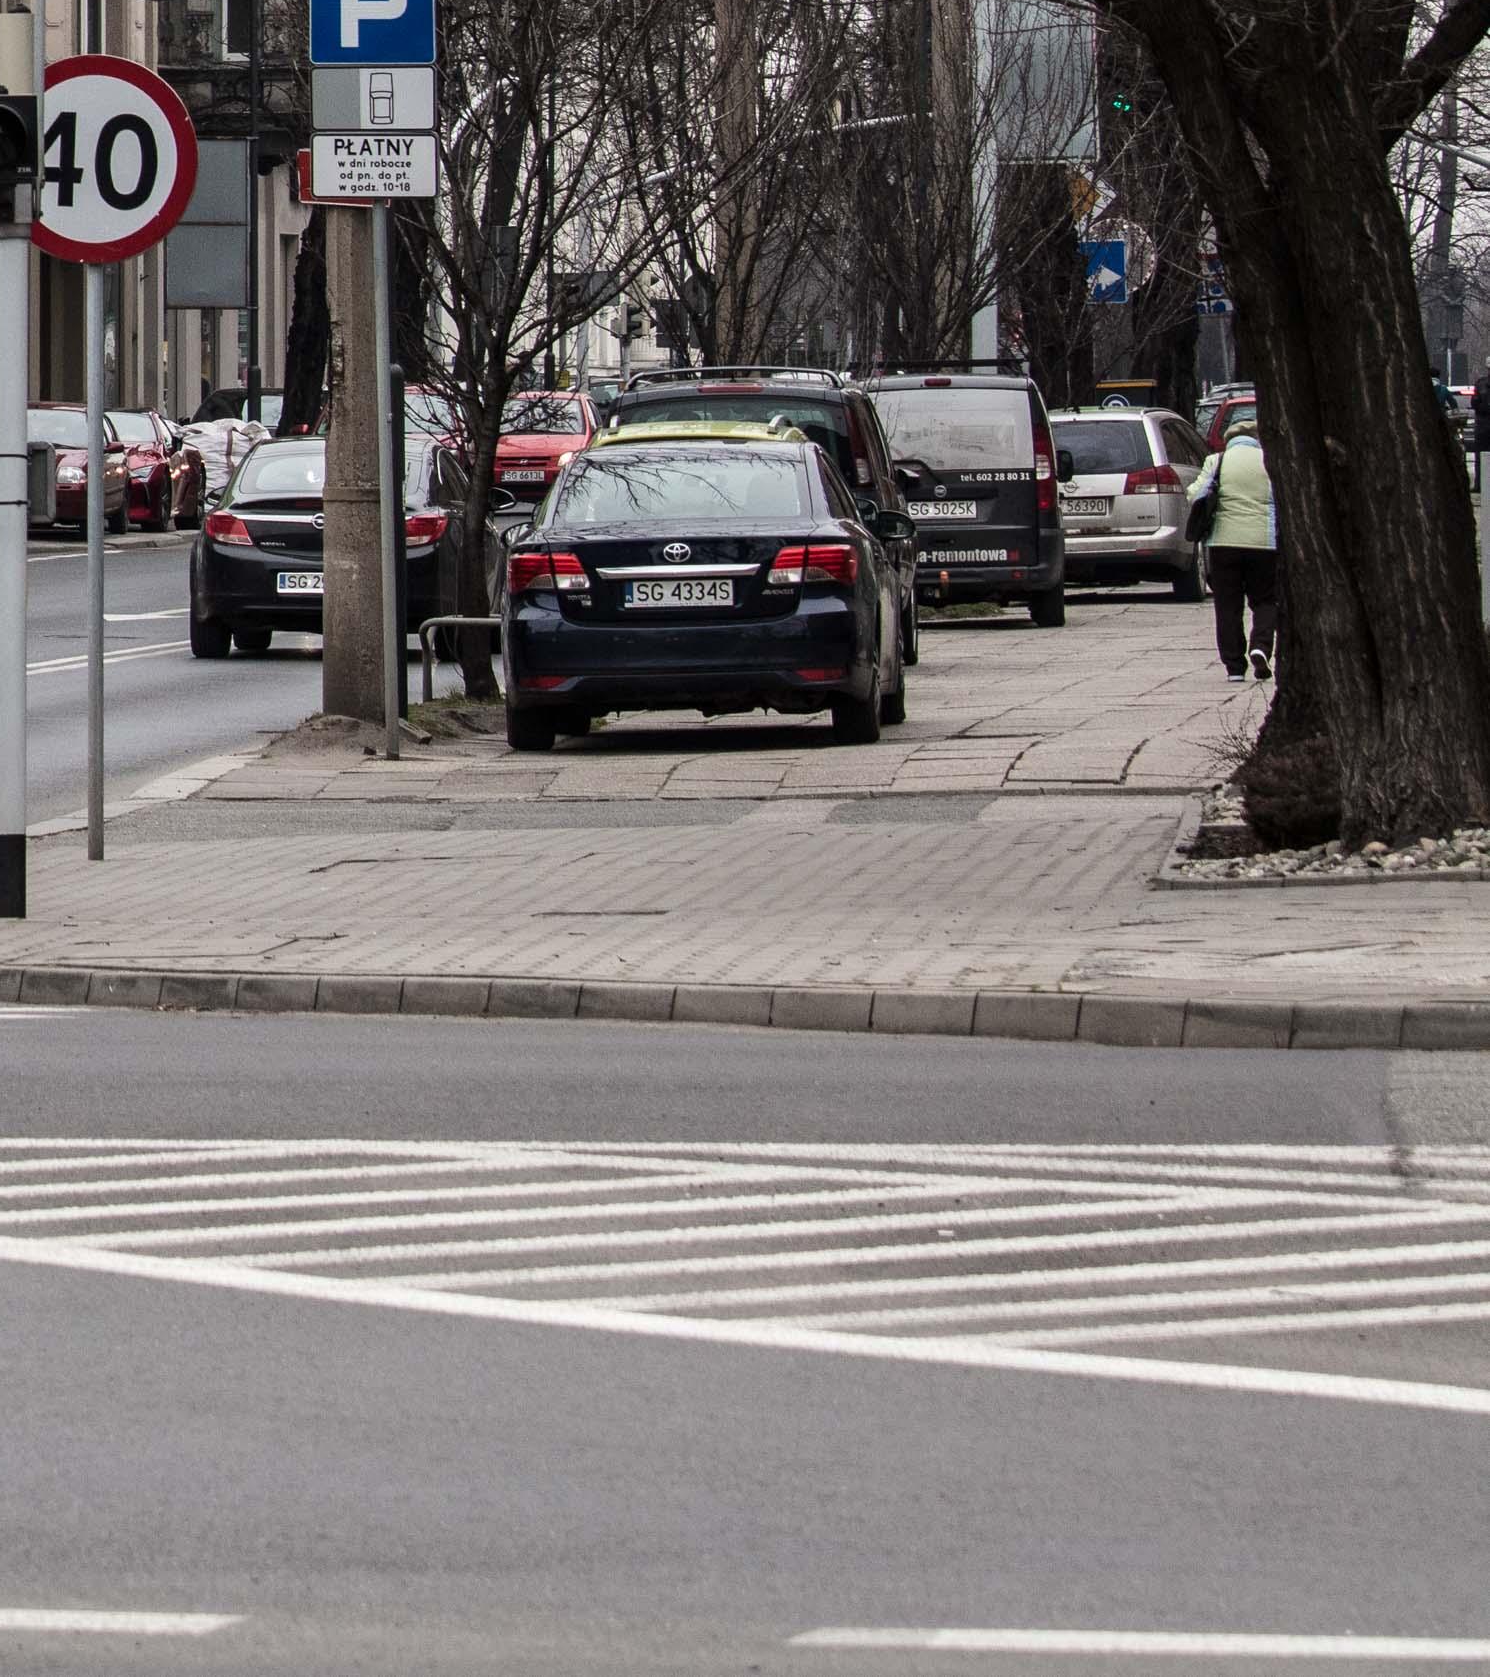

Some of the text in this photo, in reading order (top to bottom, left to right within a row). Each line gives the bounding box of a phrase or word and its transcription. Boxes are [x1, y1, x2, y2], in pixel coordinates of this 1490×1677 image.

[334, 138, 414, 156] PŁATNY
[44, 111, 158, 211] 40
[337, 159, 412, 168] w dni robocze
[340, 171, 410, 181] od pn. do pt.
[339, 183, 410, 194] w godz. 10-18
[505, 471, 517, 480] SG
[960, 472, 1030, 482] tel. 602 28 80 31
[910, 502, 974, 516] SG 5025K
[1068, 500, 1104, 512] 56390
[917, 549, 1007, 563] a-remontowa
[287, 575, 324, 589] SG 2
[636, 581, 730, 602] SG 4334S
